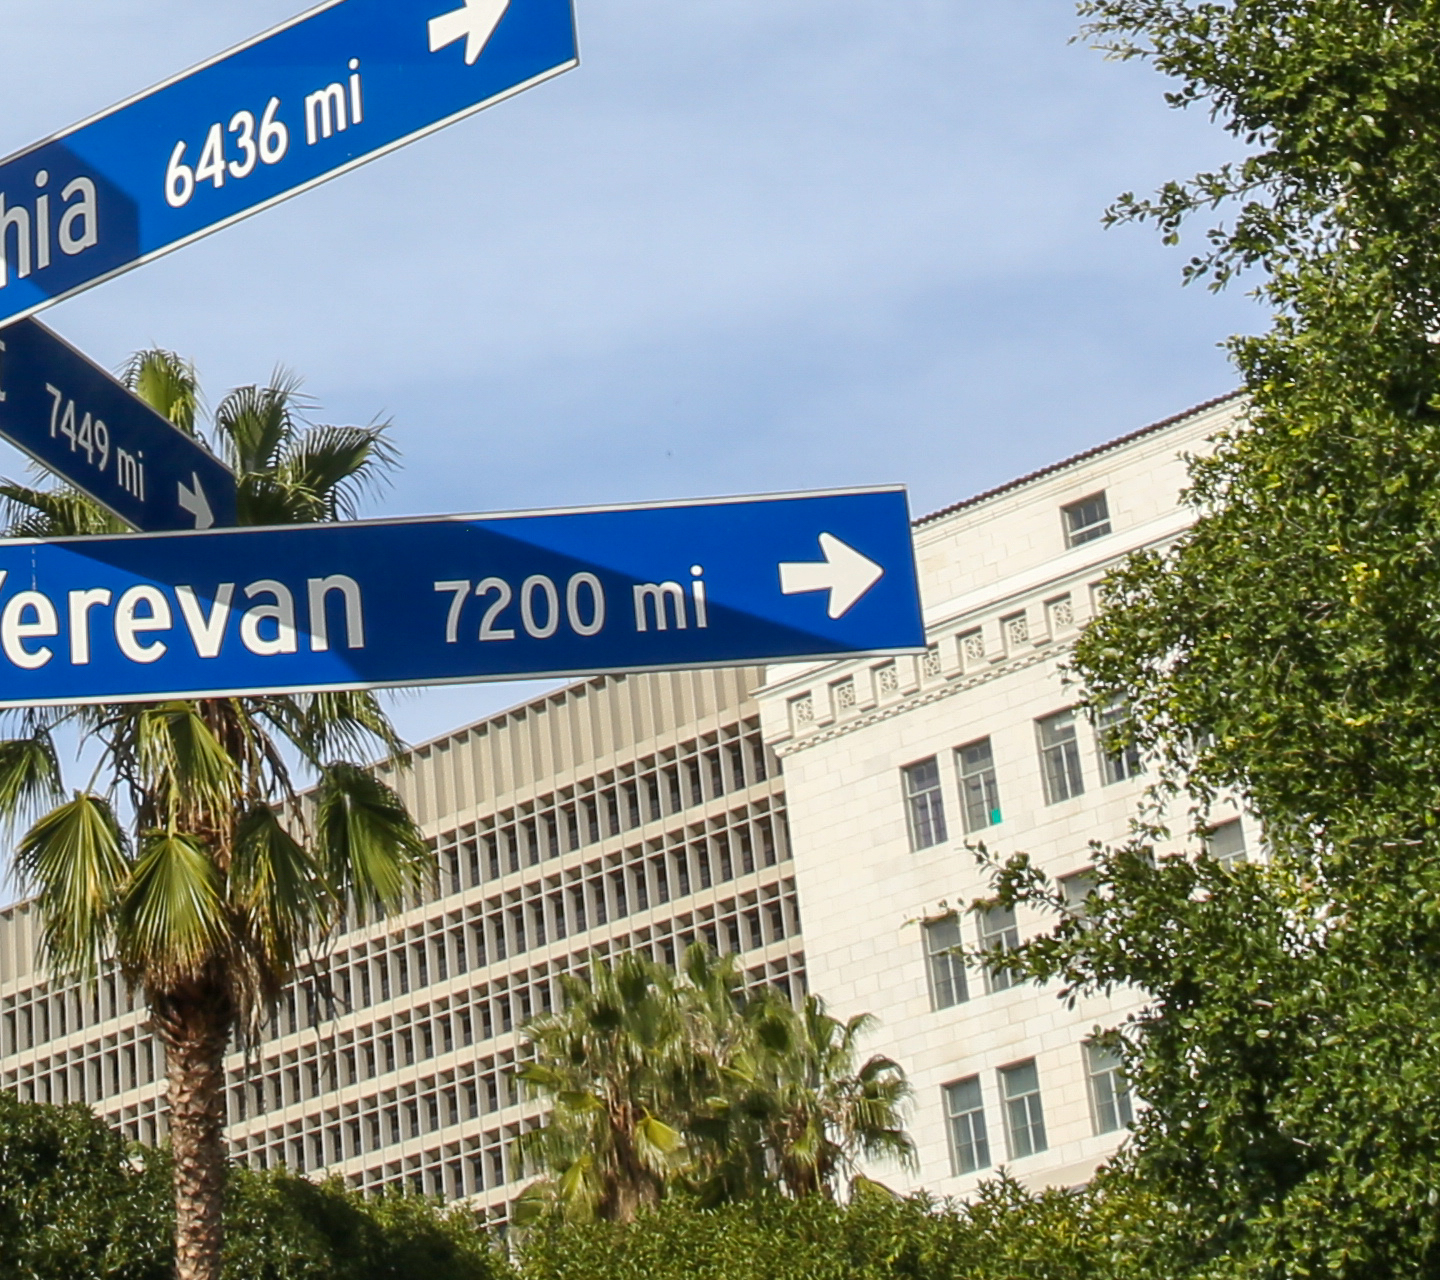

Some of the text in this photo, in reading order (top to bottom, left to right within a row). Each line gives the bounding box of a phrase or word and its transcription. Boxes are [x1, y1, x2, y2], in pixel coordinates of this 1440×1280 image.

[163, 95, 288, 209] 6436
[305, 58, 364, 147] mi
[45, 382, 146, 503] 7449 mi
[432, 571, 607, 645] 7200
[633, 565, 710, 634] mi
